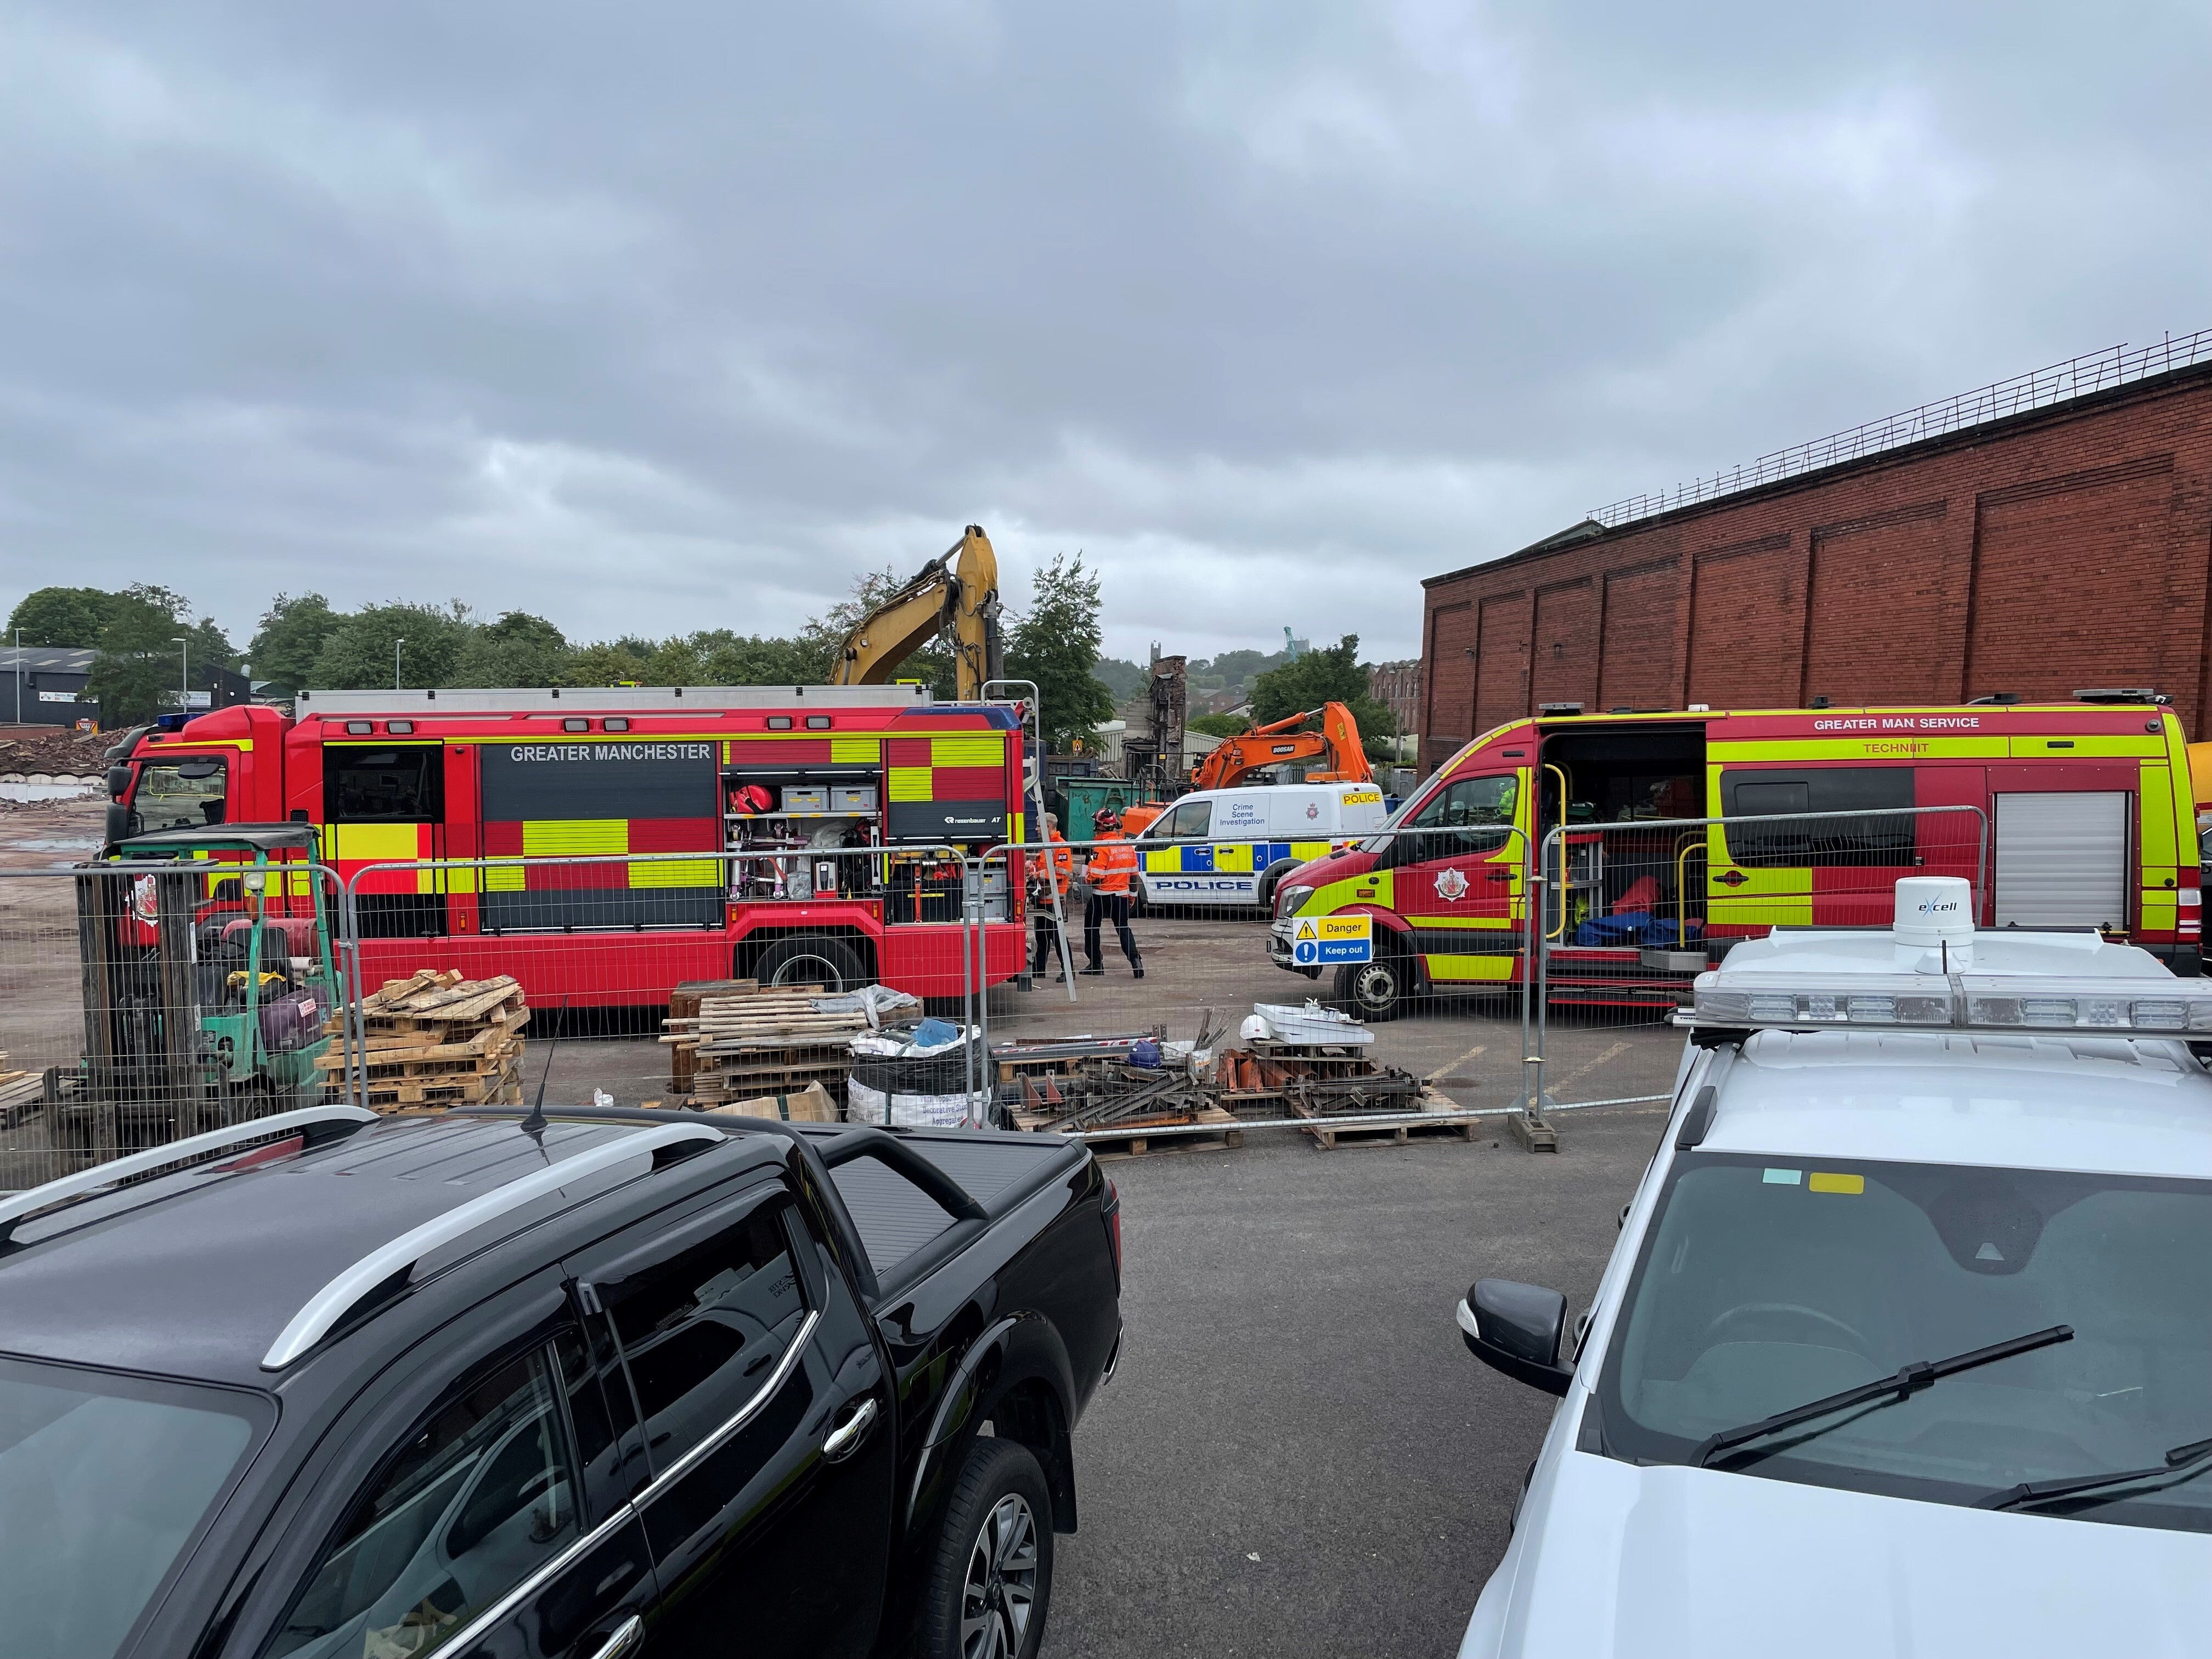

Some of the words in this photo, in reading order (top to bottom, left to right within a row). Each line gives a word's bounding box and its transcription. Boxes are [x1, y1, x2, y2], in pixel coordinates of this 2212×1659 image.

[1814, 719, 1877, 730] GREATER
[1920, 718, 1979, 728] SERVICE
[511, 746, 590, 761] GREATER
[595, 744, 710, 761] MANCHESTER
[1343, 794, 1380, 804] POLICE
[1220, 818, 1265, 827] Investigation
[1156, 881, 1252, 890] POLICE
[1327, 924, 1362, 934] Danger
[1325, 946, 1347, 956] Keep
